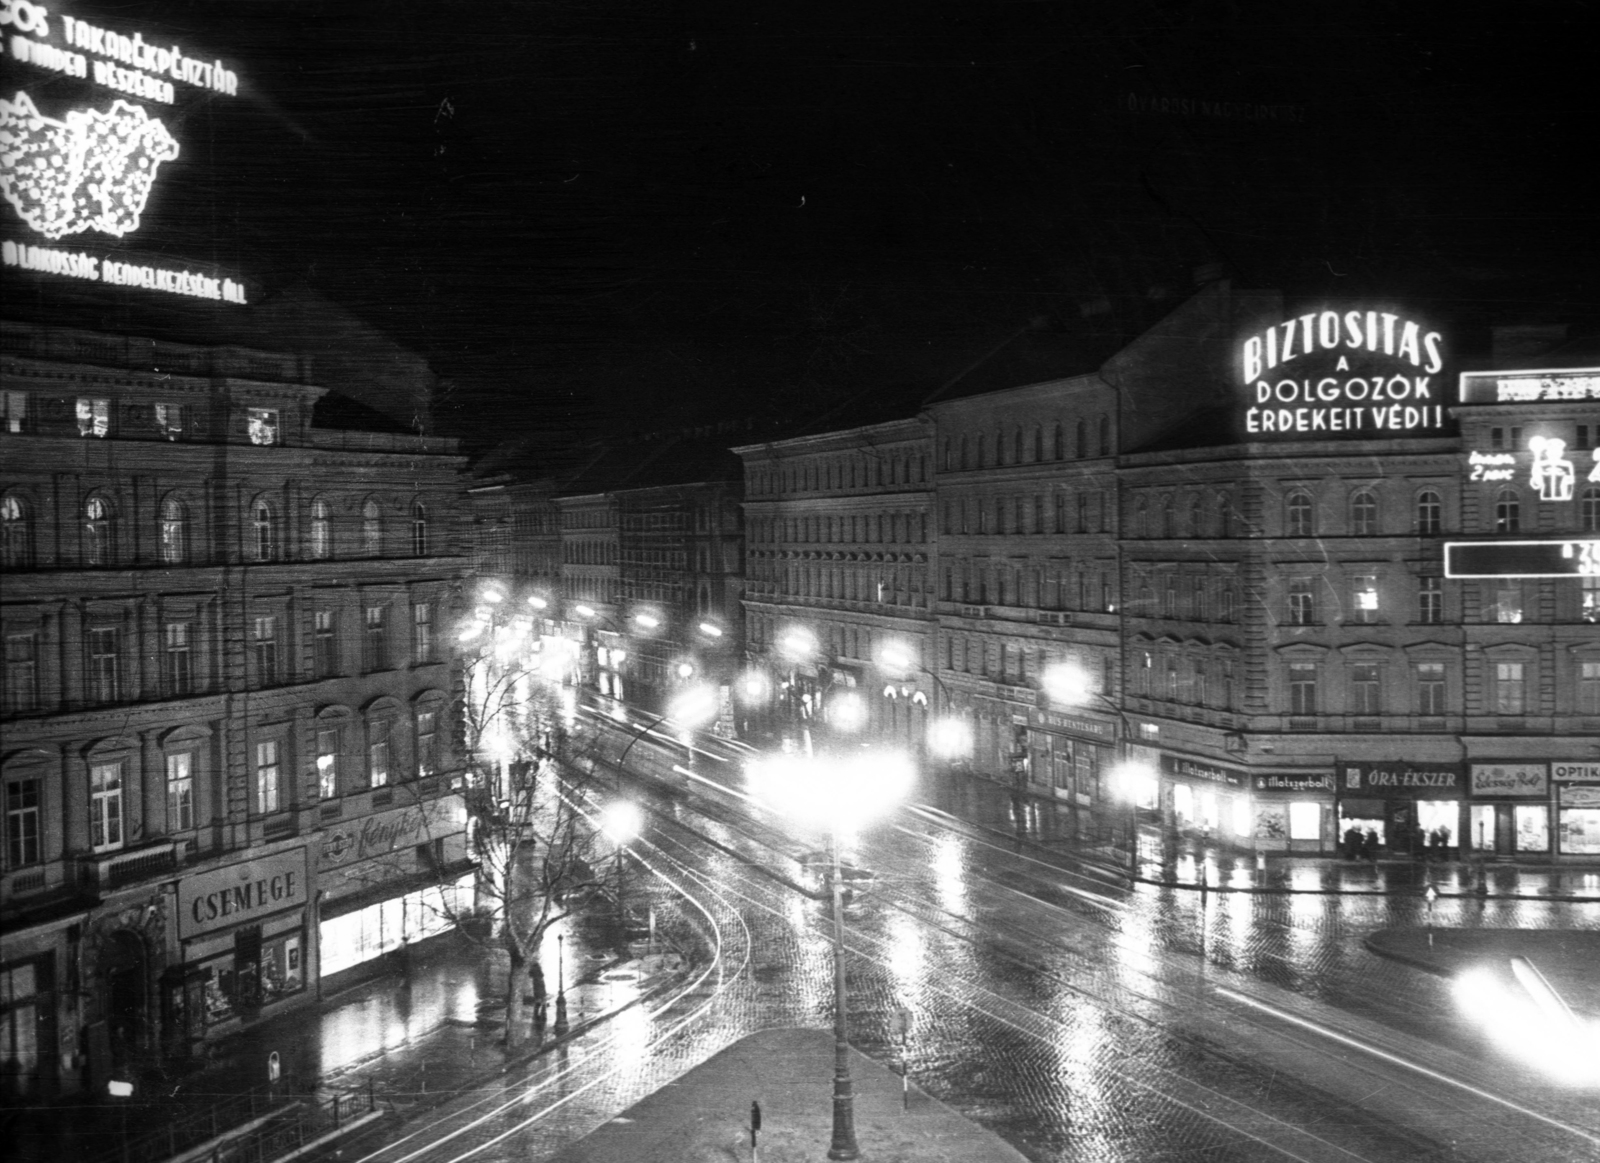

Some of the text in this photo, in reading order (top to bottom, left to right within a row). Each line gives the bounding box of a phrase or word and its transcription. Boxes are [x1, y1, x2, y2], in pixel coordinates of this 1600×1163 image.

[61, 14, 237, 96] TAKARÉKPÉNZTÁR
[19, 243, 99, 281] LAKOSSÁG
[1336, 355, 1349, 372] A
[1257, 373, 1430, 403] DOLGOZÓK
[1246, 407, 1365, 432] ÉRDEKEIT
[1368, 769, 1456, 787] ÓRA-ÉKSZER
[1555, 766, 1600, 778] OPTIK
[192, 871, 296, 925] CSEMEGE
